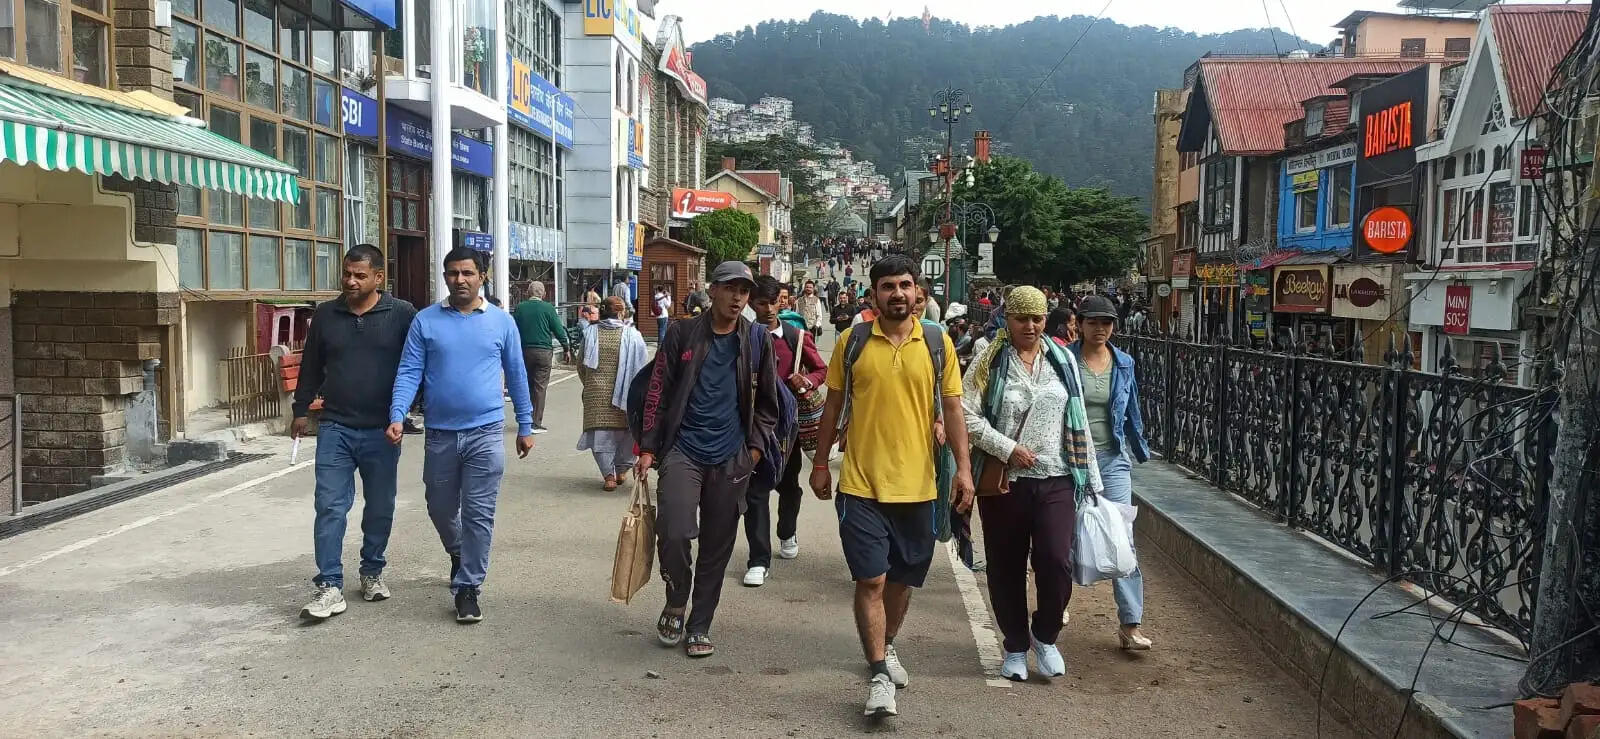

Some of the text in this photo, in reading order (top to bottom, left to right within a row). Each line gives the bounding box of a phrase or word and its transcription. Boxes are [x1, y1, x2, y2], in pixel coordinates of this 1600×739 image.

[512, 64, 529, 107] LIC
[342, 95, 362, 127] SBI
[1365, 101, 1412, 159] BARISTA
[400, 135, 412, 147] State
[413, 139, 425, 150] Bank
[1524, 155, 1544, 165] MIN
[1367, 219, 1407, 239] BARISTA
[1447, 296, 1468, 308] MINI
